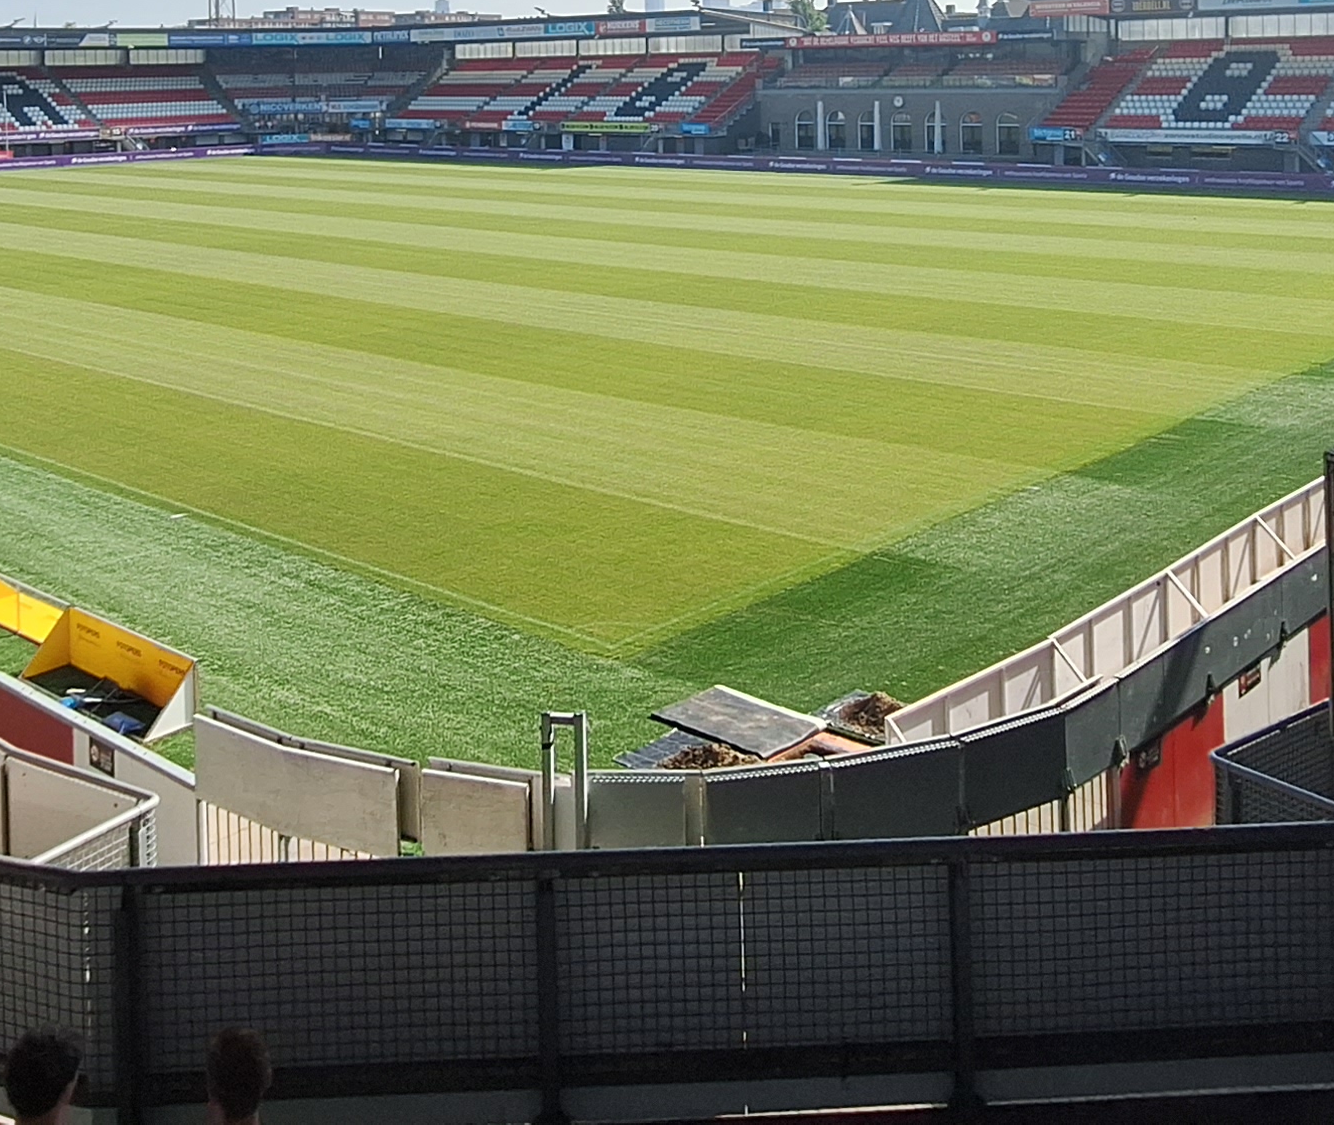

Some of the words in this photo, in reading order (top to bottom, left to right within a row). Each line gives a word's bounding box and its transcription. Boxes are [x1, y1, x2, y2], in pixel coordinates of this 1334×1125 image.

[548, 21, 590, 35] LOGIX
[254, 32, 301, 44] LOGIX
[325, 32, 366, 44] LOGIX
[1275, 133, 1289, 142] 22
